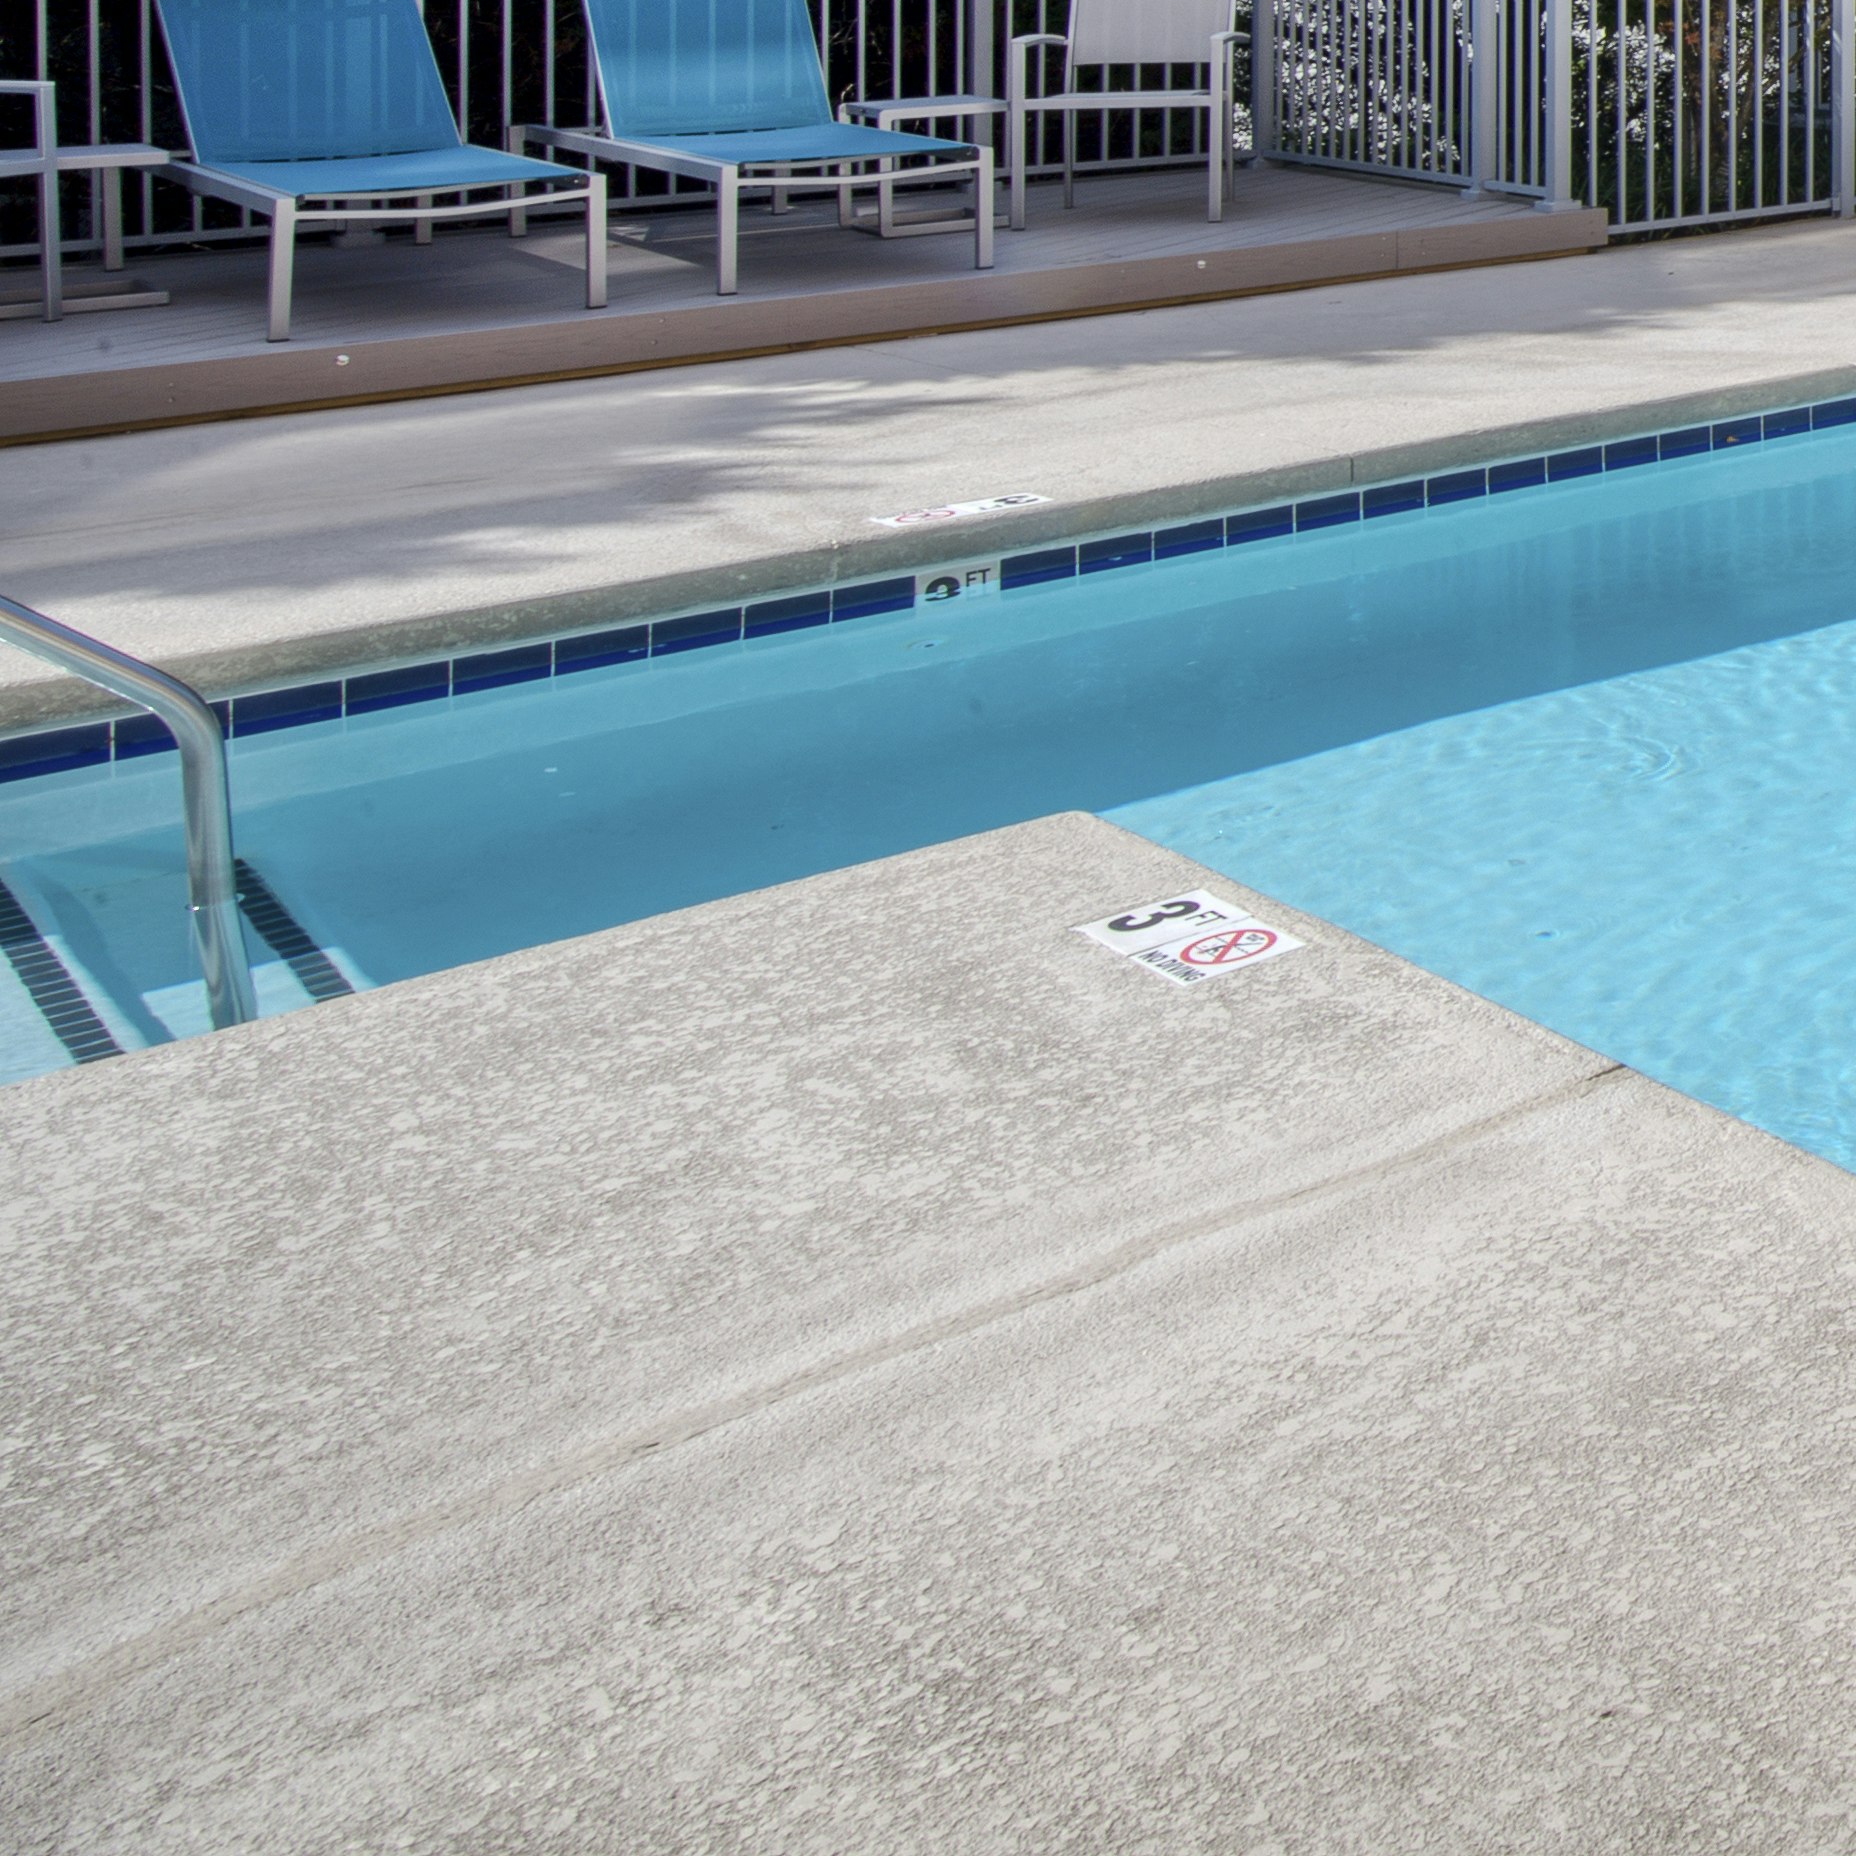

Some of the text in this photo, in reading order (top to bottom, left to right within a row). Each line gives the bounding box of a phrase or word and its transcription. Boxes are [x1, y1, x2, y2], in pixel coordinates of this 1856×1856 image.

[965, 568, 992, 588] FT
[1107, 900, 1229, 932] 3 FT
[1138, 950, 1206, 982] NO DIVING
